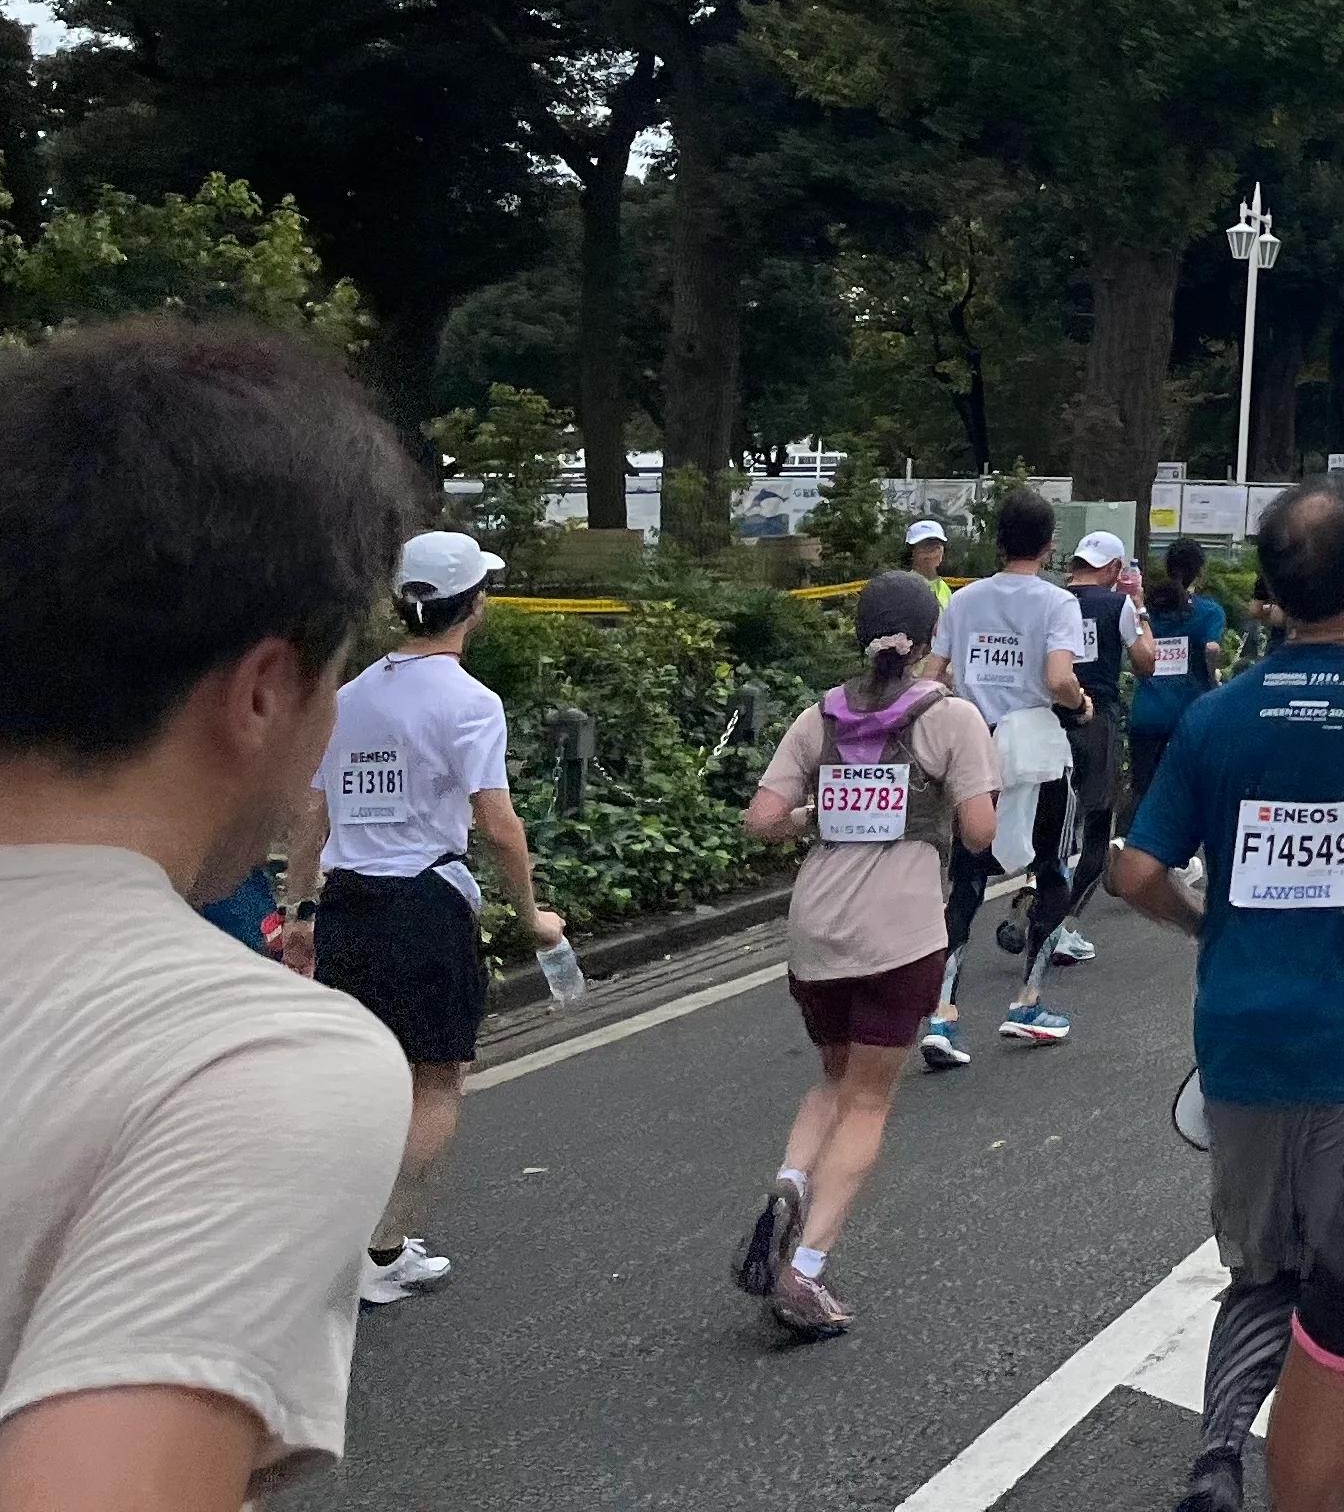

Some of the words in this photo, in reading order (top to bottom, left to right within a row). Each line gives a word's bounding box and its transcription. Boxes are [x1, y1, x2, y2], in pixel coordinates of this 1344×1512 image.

[987, 635, 1020, 646] ENEOS
[969, 648, 1024, 667] F14414
[359, 751, 398, 763] ENEOS
[342, 769, 403, 795] E13181
[843, 768, 895, 780] ENEOS
[821, 787, 905, 811] G32782
[1273, 807, 1339, 824] ENEOS
[830, 825, 891, 835] NISSAN
[1251, 884, 1332, 900] LAWSON
